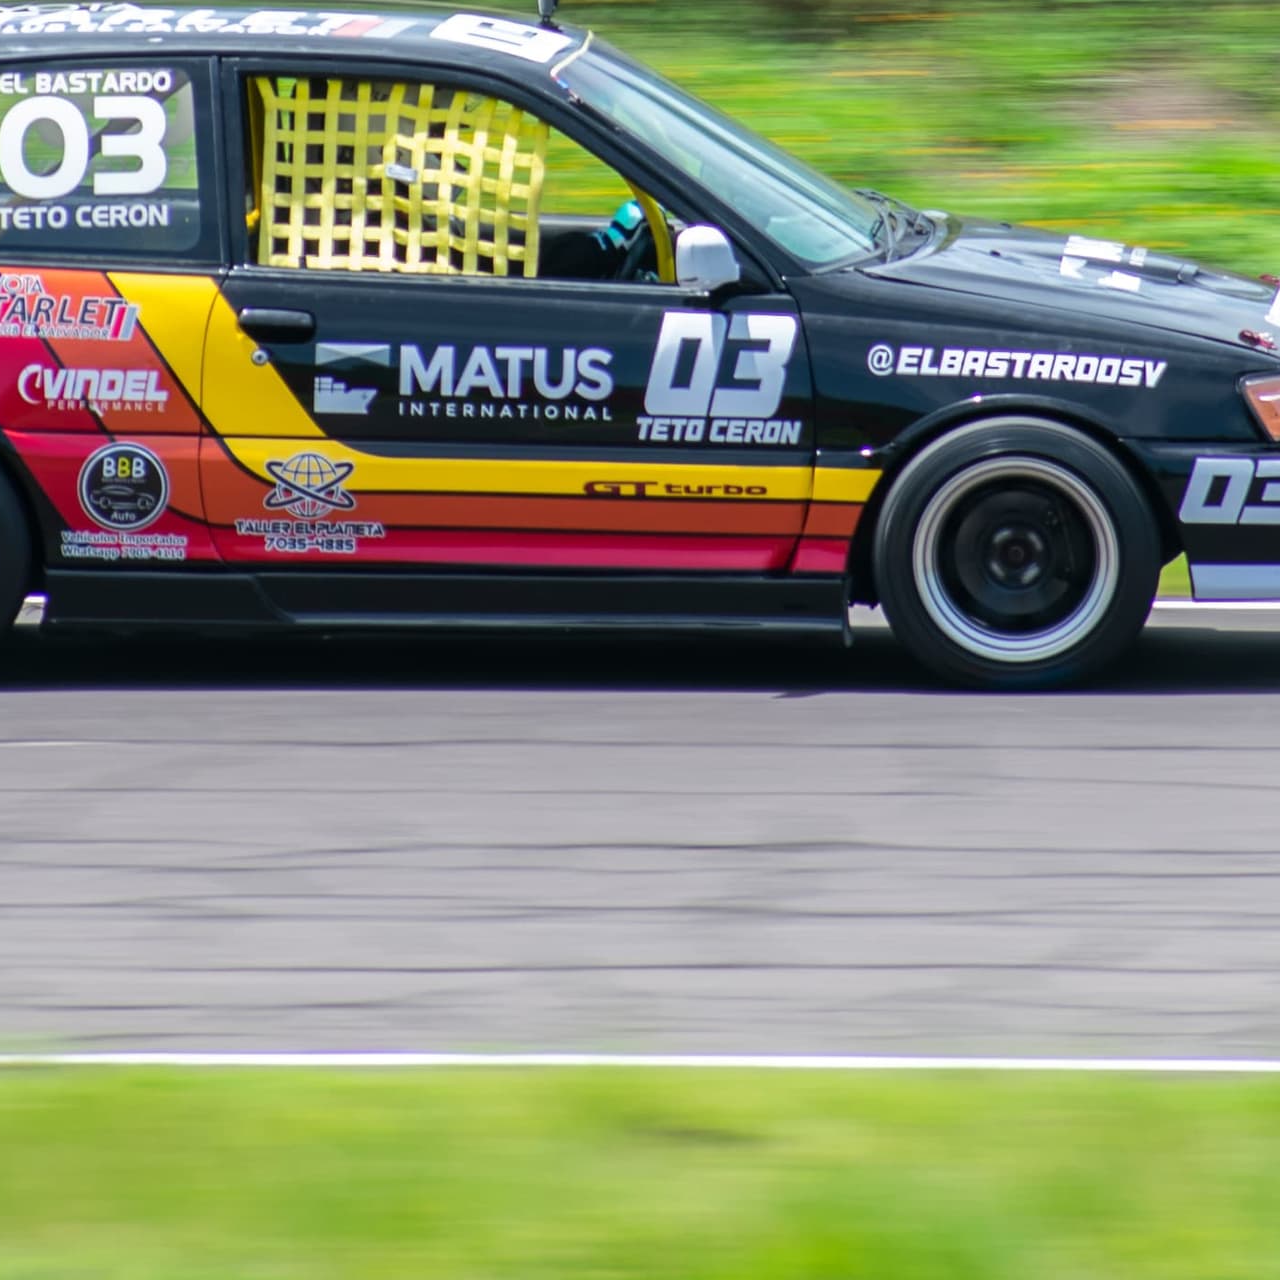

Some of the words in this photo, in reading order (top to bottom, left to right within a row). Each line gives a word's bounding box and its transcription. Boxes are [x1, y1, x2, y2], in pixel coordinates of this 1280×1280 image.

[35, 70, 171, 93] BASTARDO
[75, 203, 169, 229] CERON
[22, 323, 37, 338] EL
[39, 324, 109, 340] SALVADOR
[399, 344, 614, 400] MATUS
[644, 311, 798, 418] 03
[867, 343, 1168, 389] @ELBASTARDOSV
[399, 401, 613, 421] INTERNATIONAL
[636, 416, 705, 442] TETO
[709, 418, 801, 445] CERON
[583, 481, 659, 496] GT
[664, 483, 768, 496] turbo
[111, 511, 137, 521] Auto
[235, 520, 290, 536] TALLER
[293, 522, 314, 536] EL
[119, 532, 187, 545] Importados
[265, 536, 355, 553] 7035-4885
[62, 544, 119, 560] Whatsapp
